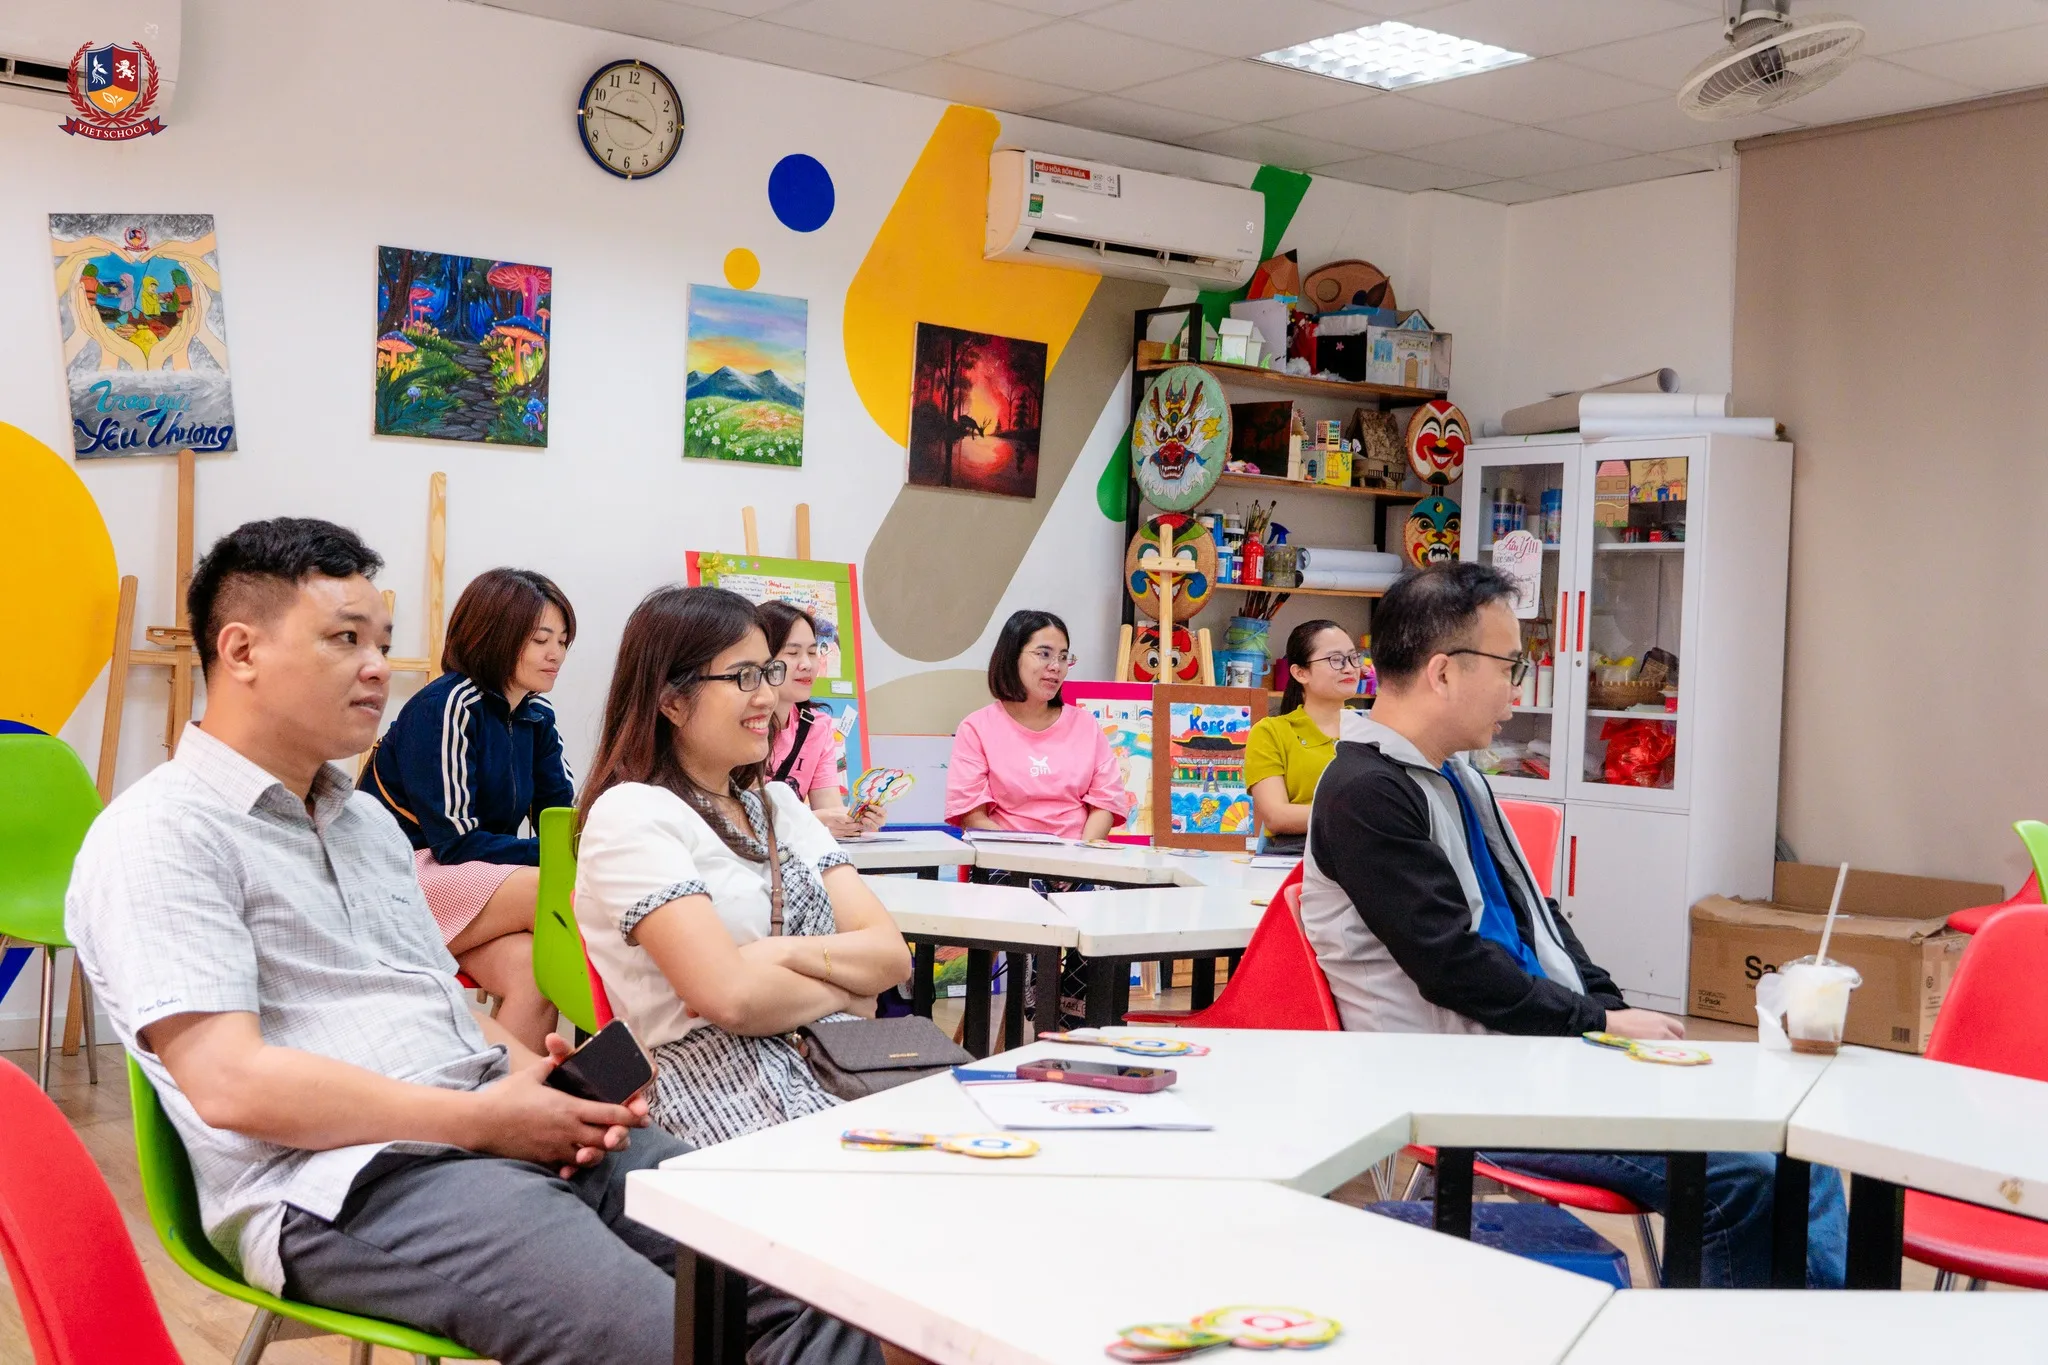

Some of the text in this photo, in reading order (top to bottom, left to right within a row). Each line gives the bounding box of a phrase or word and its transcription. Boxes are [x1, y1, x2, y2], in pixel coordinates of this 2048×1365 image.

[609, 75, 620, 88] 11
[628, 71, 640, 85] 12
[594, 88, 606, 101] 10
[651, 82, 656, 94] 1
[663, 100, 670, 112] 2
[586, 107, 594, 120] 9
[667, 120, 674, 133] 3
[591, 130, 599, 143] 8
[658, 141, 664, 153] 4
[606, 148, 614, 161] 7
[642, 155, 648, 167] 5
[624, 156, 630, 169] 6
[88, 379, 150, 413] Trao
[73, 417, 144, 454] Yêu
[1189, 714, 1237, 732] Korea
[877, 776, 894, 792] 3
[1698, 996, 1721, 1006] 1-Pack
